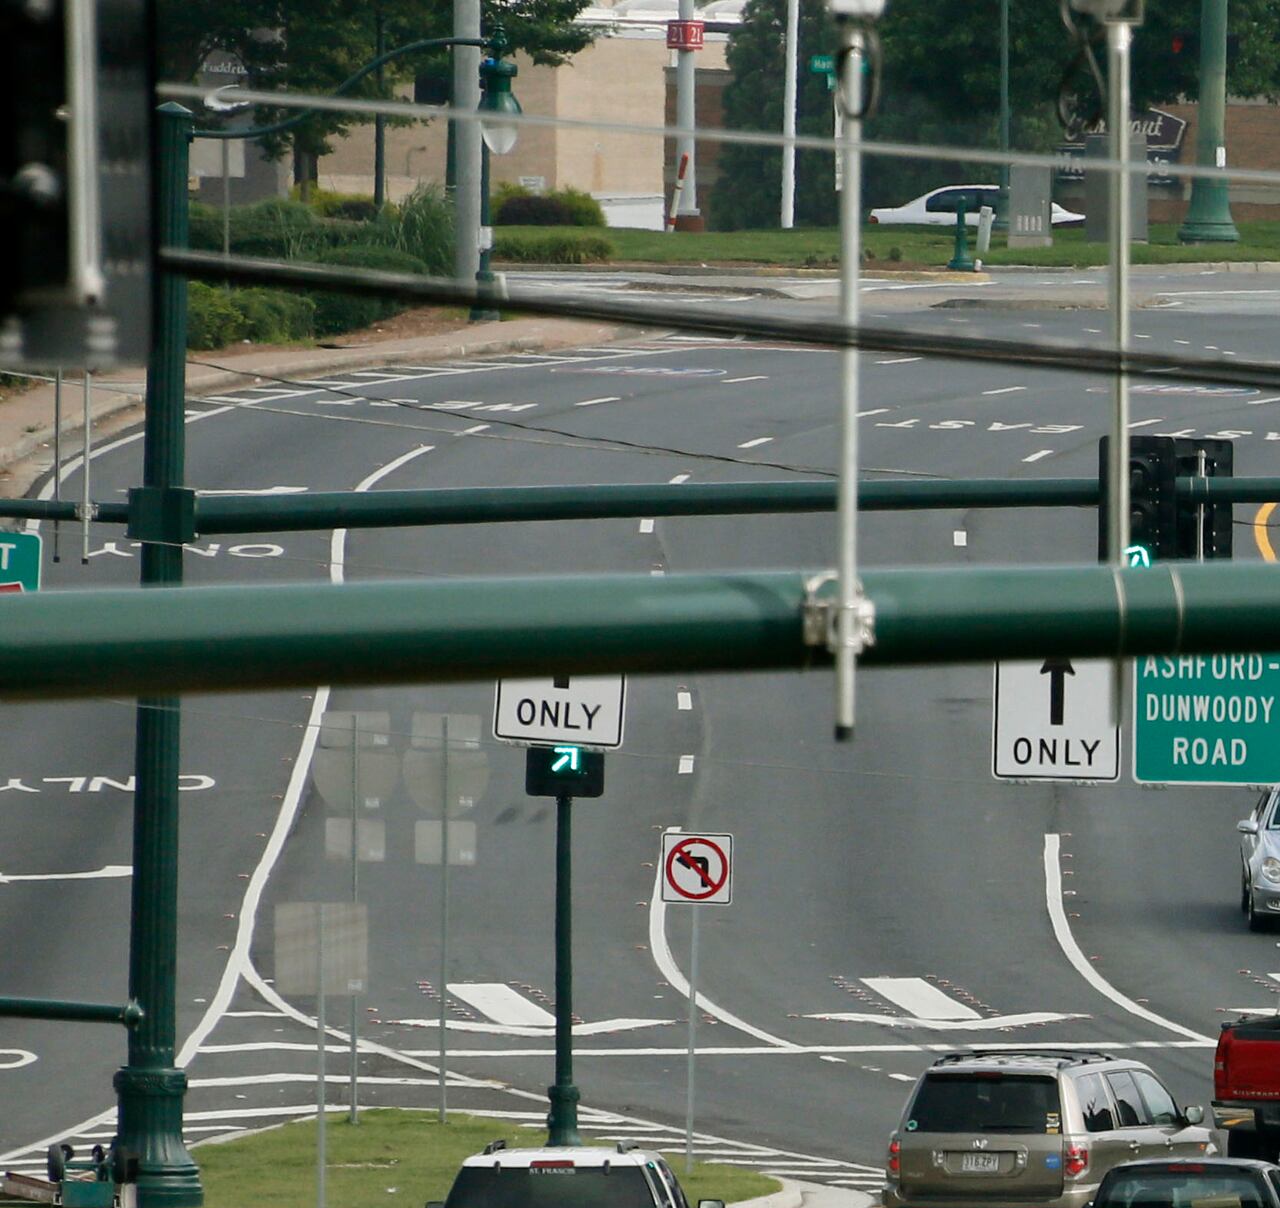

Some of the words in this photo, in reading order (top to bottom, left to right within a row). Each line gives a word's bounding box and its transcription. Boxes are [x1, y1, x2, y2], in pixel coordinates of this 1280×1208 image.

[1143, 652, 1280, 680] ASHFORD-
[516, 698, 602, 731] ONLY
[1146, 693, 1275, 724] DUNWOODY
[1013, 737, 1101, 767] ONLY
[1173, 737, 1247, 766] ROAD
